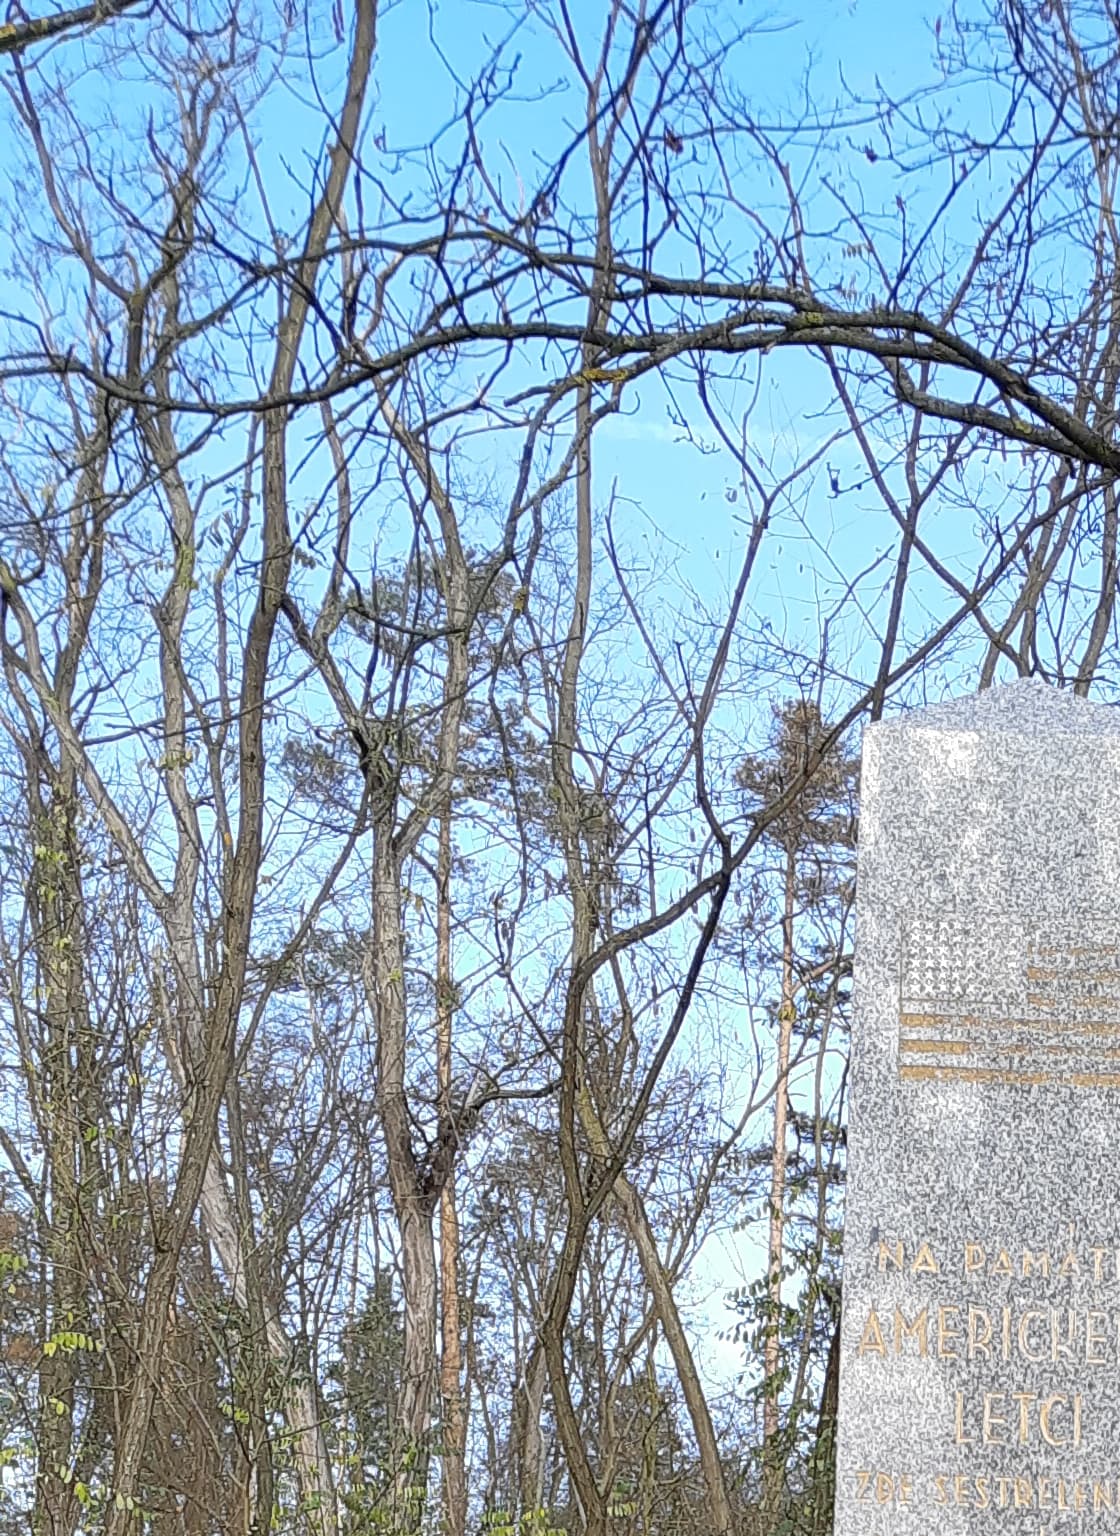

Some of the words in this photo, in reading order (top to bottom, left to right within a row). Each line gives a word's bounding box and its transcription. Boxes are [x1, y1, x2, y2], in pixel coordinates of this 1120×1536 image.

[877, 1241, 938, 1274] NA
[954, 1390, 1083, 1446] LETCI
[855, 1470, 913, 1505] ZDE
